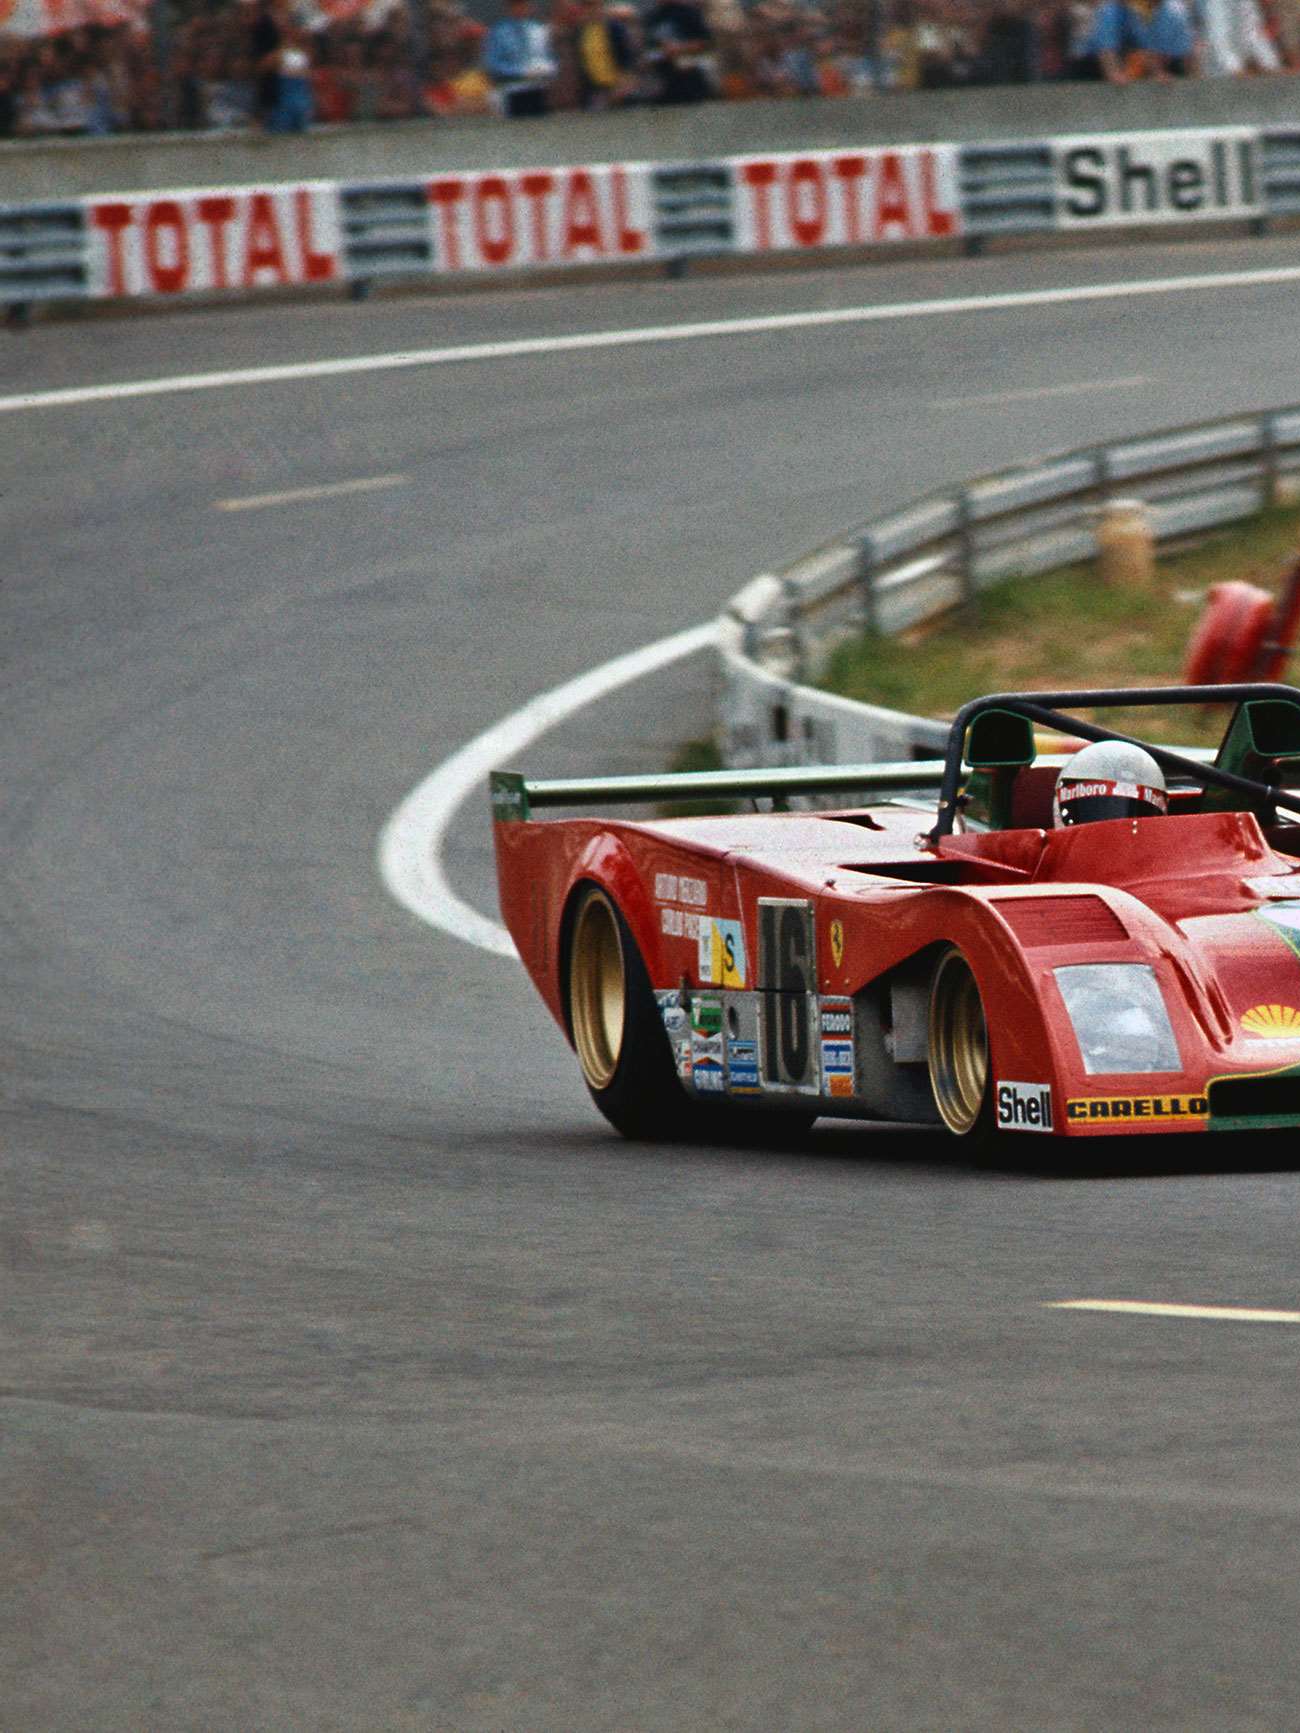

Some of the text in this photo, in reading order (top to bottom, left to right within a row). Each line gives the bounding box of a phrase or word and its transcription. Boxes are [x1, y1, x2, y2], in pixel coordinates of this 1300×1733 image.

[426, 166, 643, 267] TOTAL
[743, 151, 955, 249] TOTAL
[1064, 140, 1254, 216] Shell
[93, 189, 335, 294] TOTAL
[1060, 783, 1107, 801] Marlboro
[763, 905, 809, 1082] 16
[999, 1087, 1053, 1128] Shell
[1068, 1097, 1208, 1119] CARELLO
